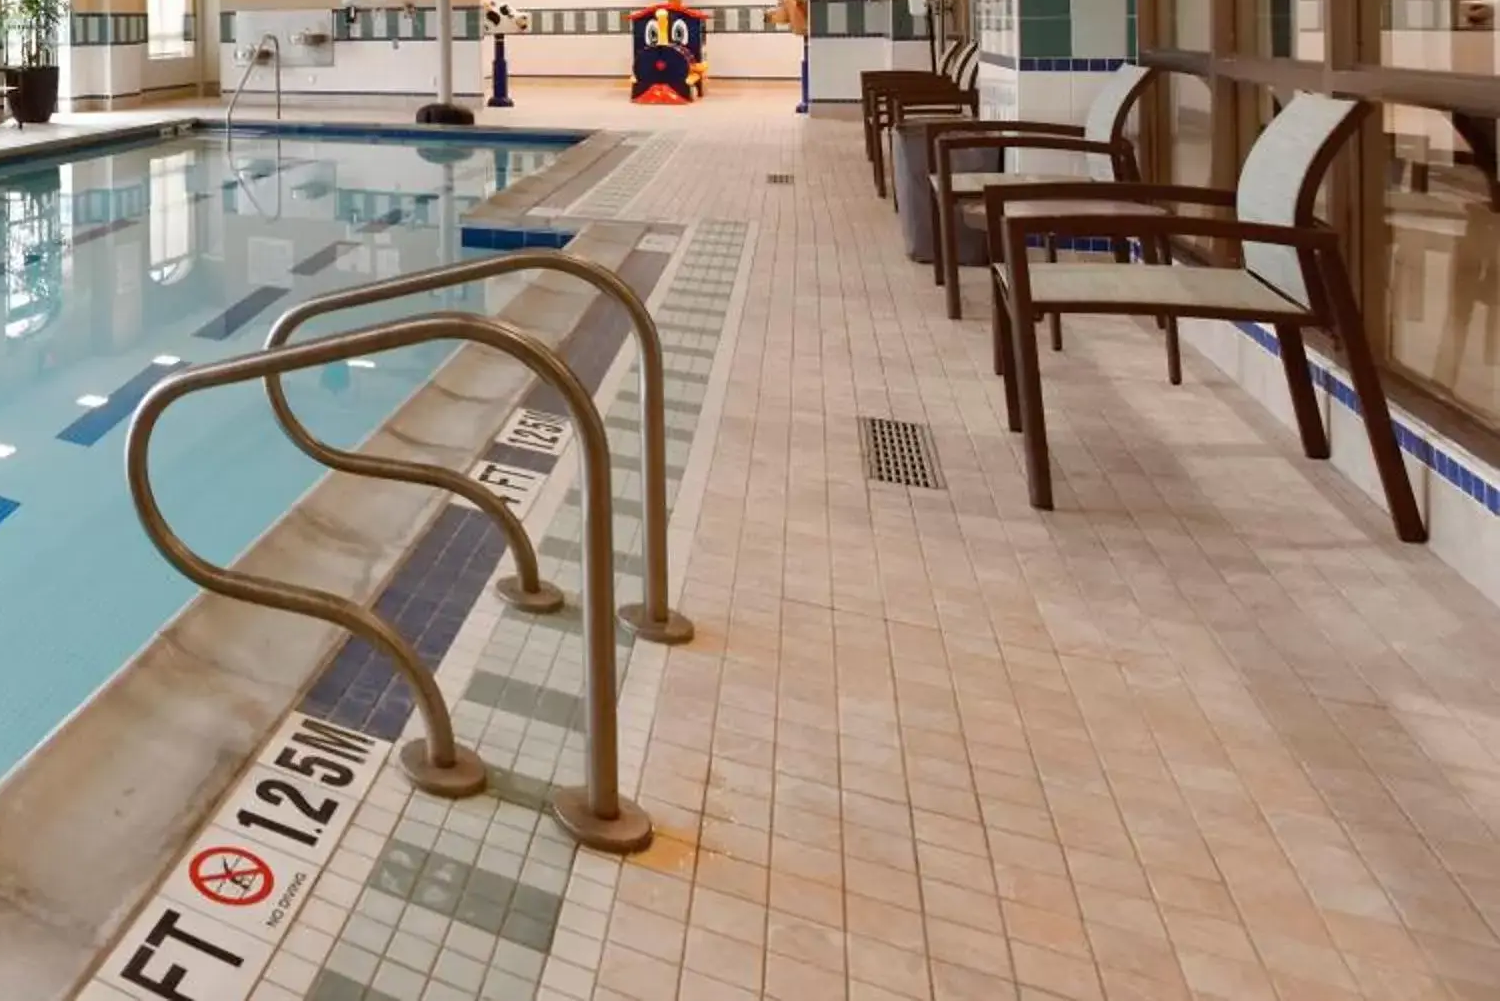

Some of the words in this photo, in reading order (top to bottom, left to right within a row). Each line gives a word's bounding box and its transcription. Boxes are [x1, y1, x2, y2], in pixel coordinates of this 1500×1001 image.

[478, 463, 536, 492] FT
[236, 717, 376, 848] 1.25M
[265, 909, 285, 928] NO
[278, 871, 307, 909] DIVING
[120, 908, 245, 1001] FT
